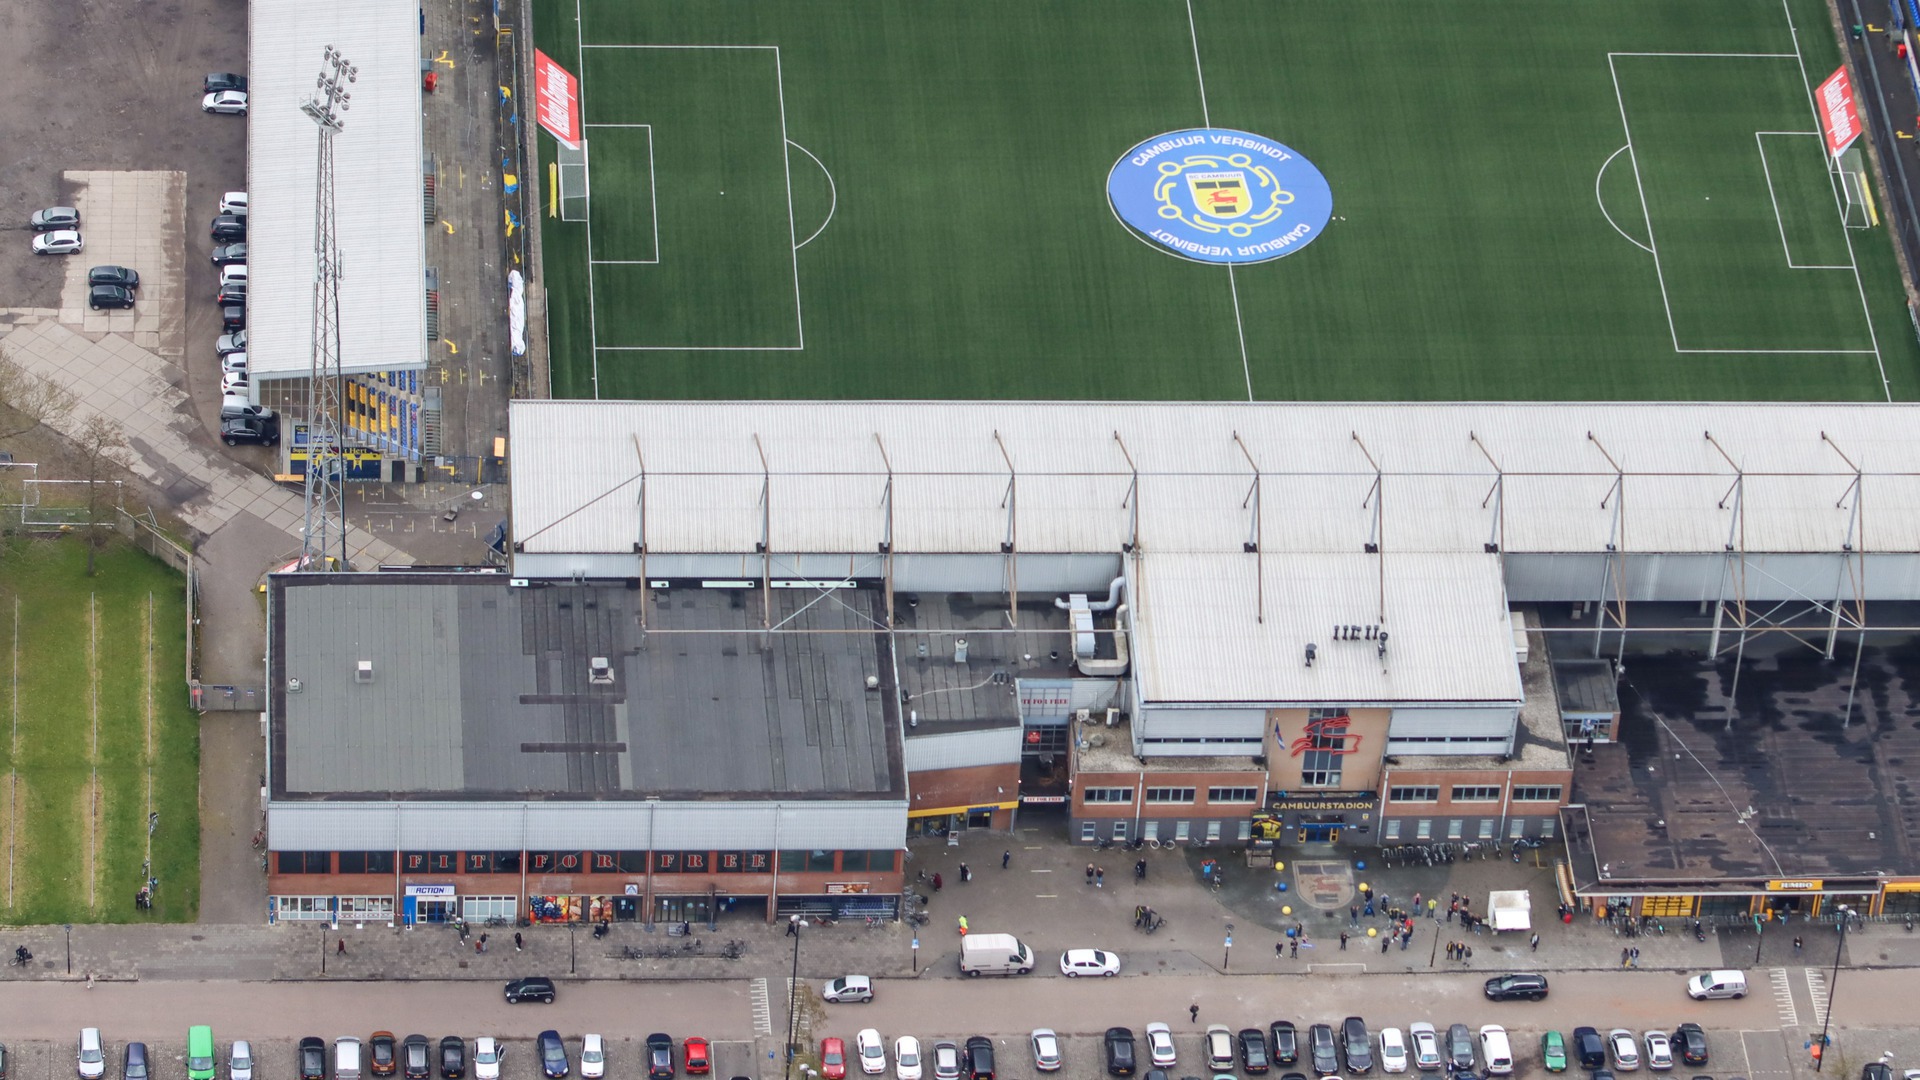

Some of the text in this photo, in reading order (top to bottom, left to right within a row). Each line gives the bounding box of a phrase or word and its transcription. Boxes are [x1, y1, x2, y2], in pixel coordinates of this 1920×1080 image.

[1131, 134, 1292, 167] CAMBUUR VERBINDT
[1149, 223, 1311, 257] CAMBUUR VERBINDT
[1272, 802, 1373, 810] CAMBUURSTADION
[408, 854, 766, 869] FIT FOR FREE
